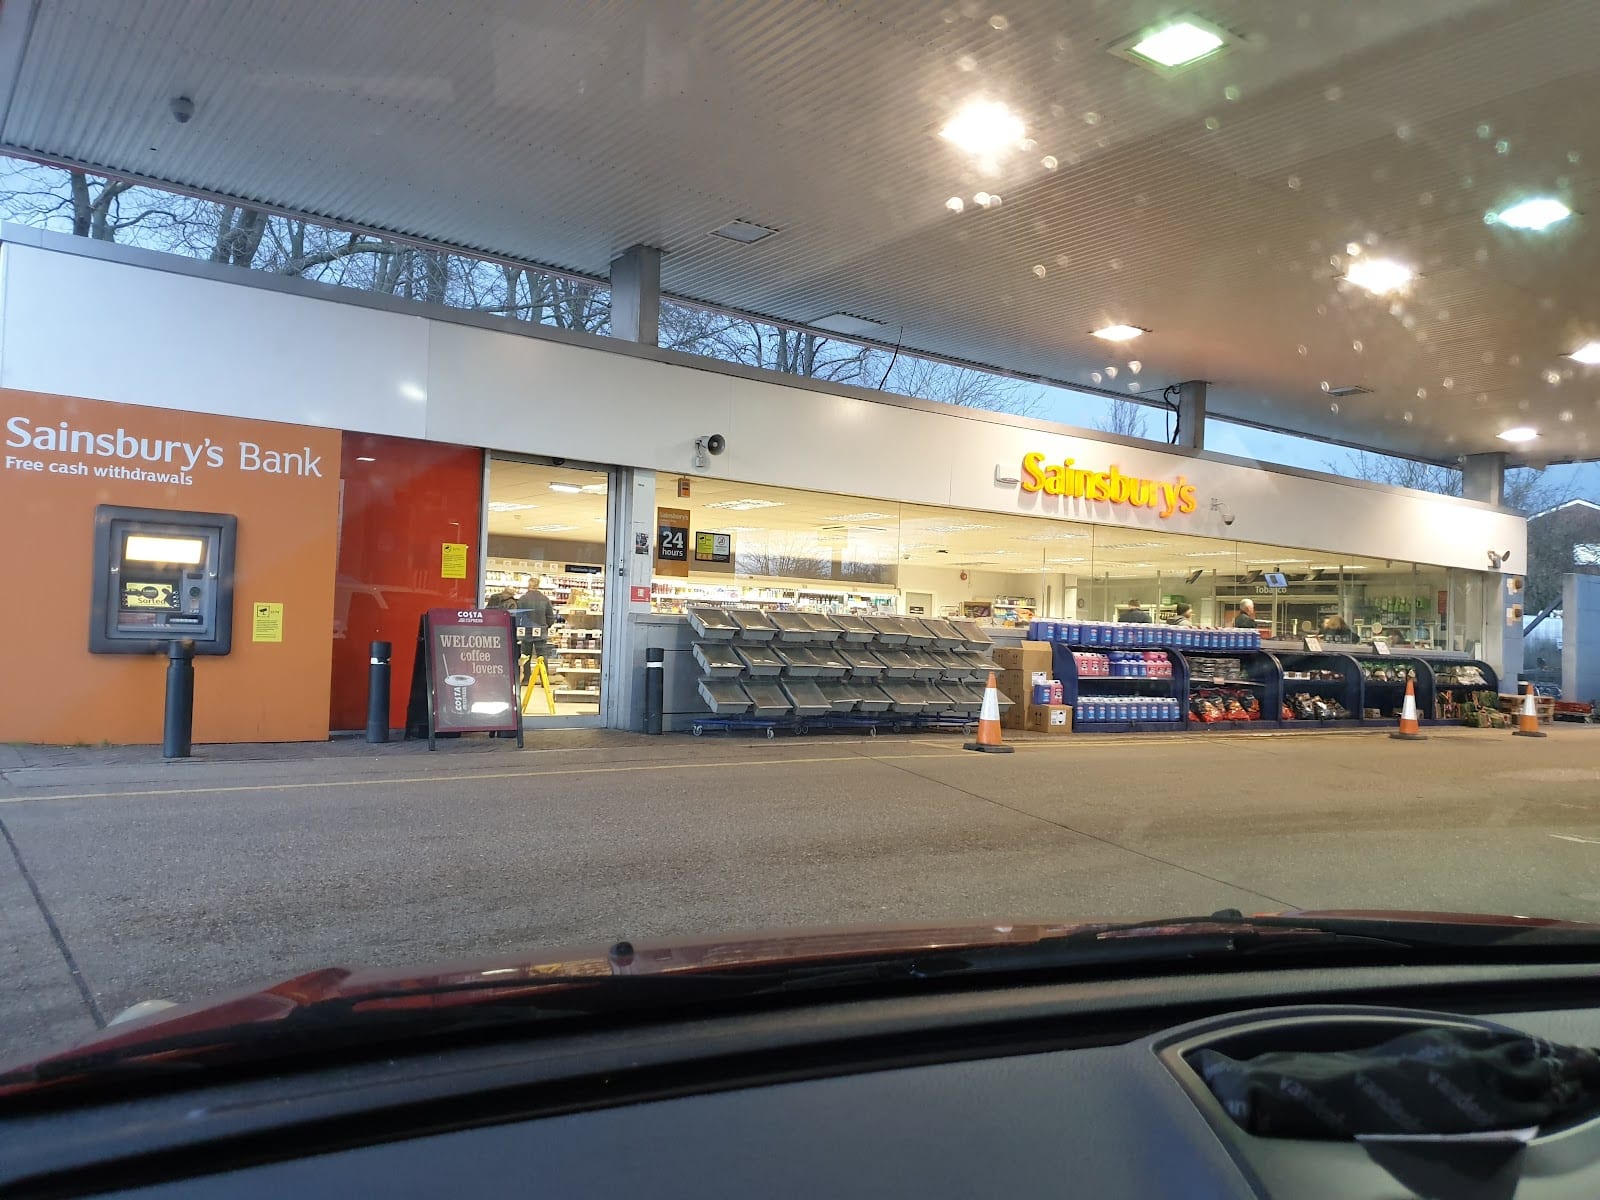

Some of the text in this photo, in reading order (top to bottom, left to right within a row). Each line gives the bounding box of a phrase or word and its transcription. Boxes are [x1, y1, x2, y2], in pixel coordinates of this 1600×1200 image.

[6, 416, 322, 478] Sainsbury's Bank
[6, 456, 193, 485] Free cash withdrawals
[1021, 451, 1197, 518] Sainsbury's
[662, 531, 684, 549] 24
[662, 547, 684, 557] hours
[1255, 586, 1287, 594] Tobaco
[440, 634, 501, 648] WELCOME
[460, 650, 491, 661] coffee
[472, 662, 504, 674] lovers
[454, 687, 462, 710] COSTA
